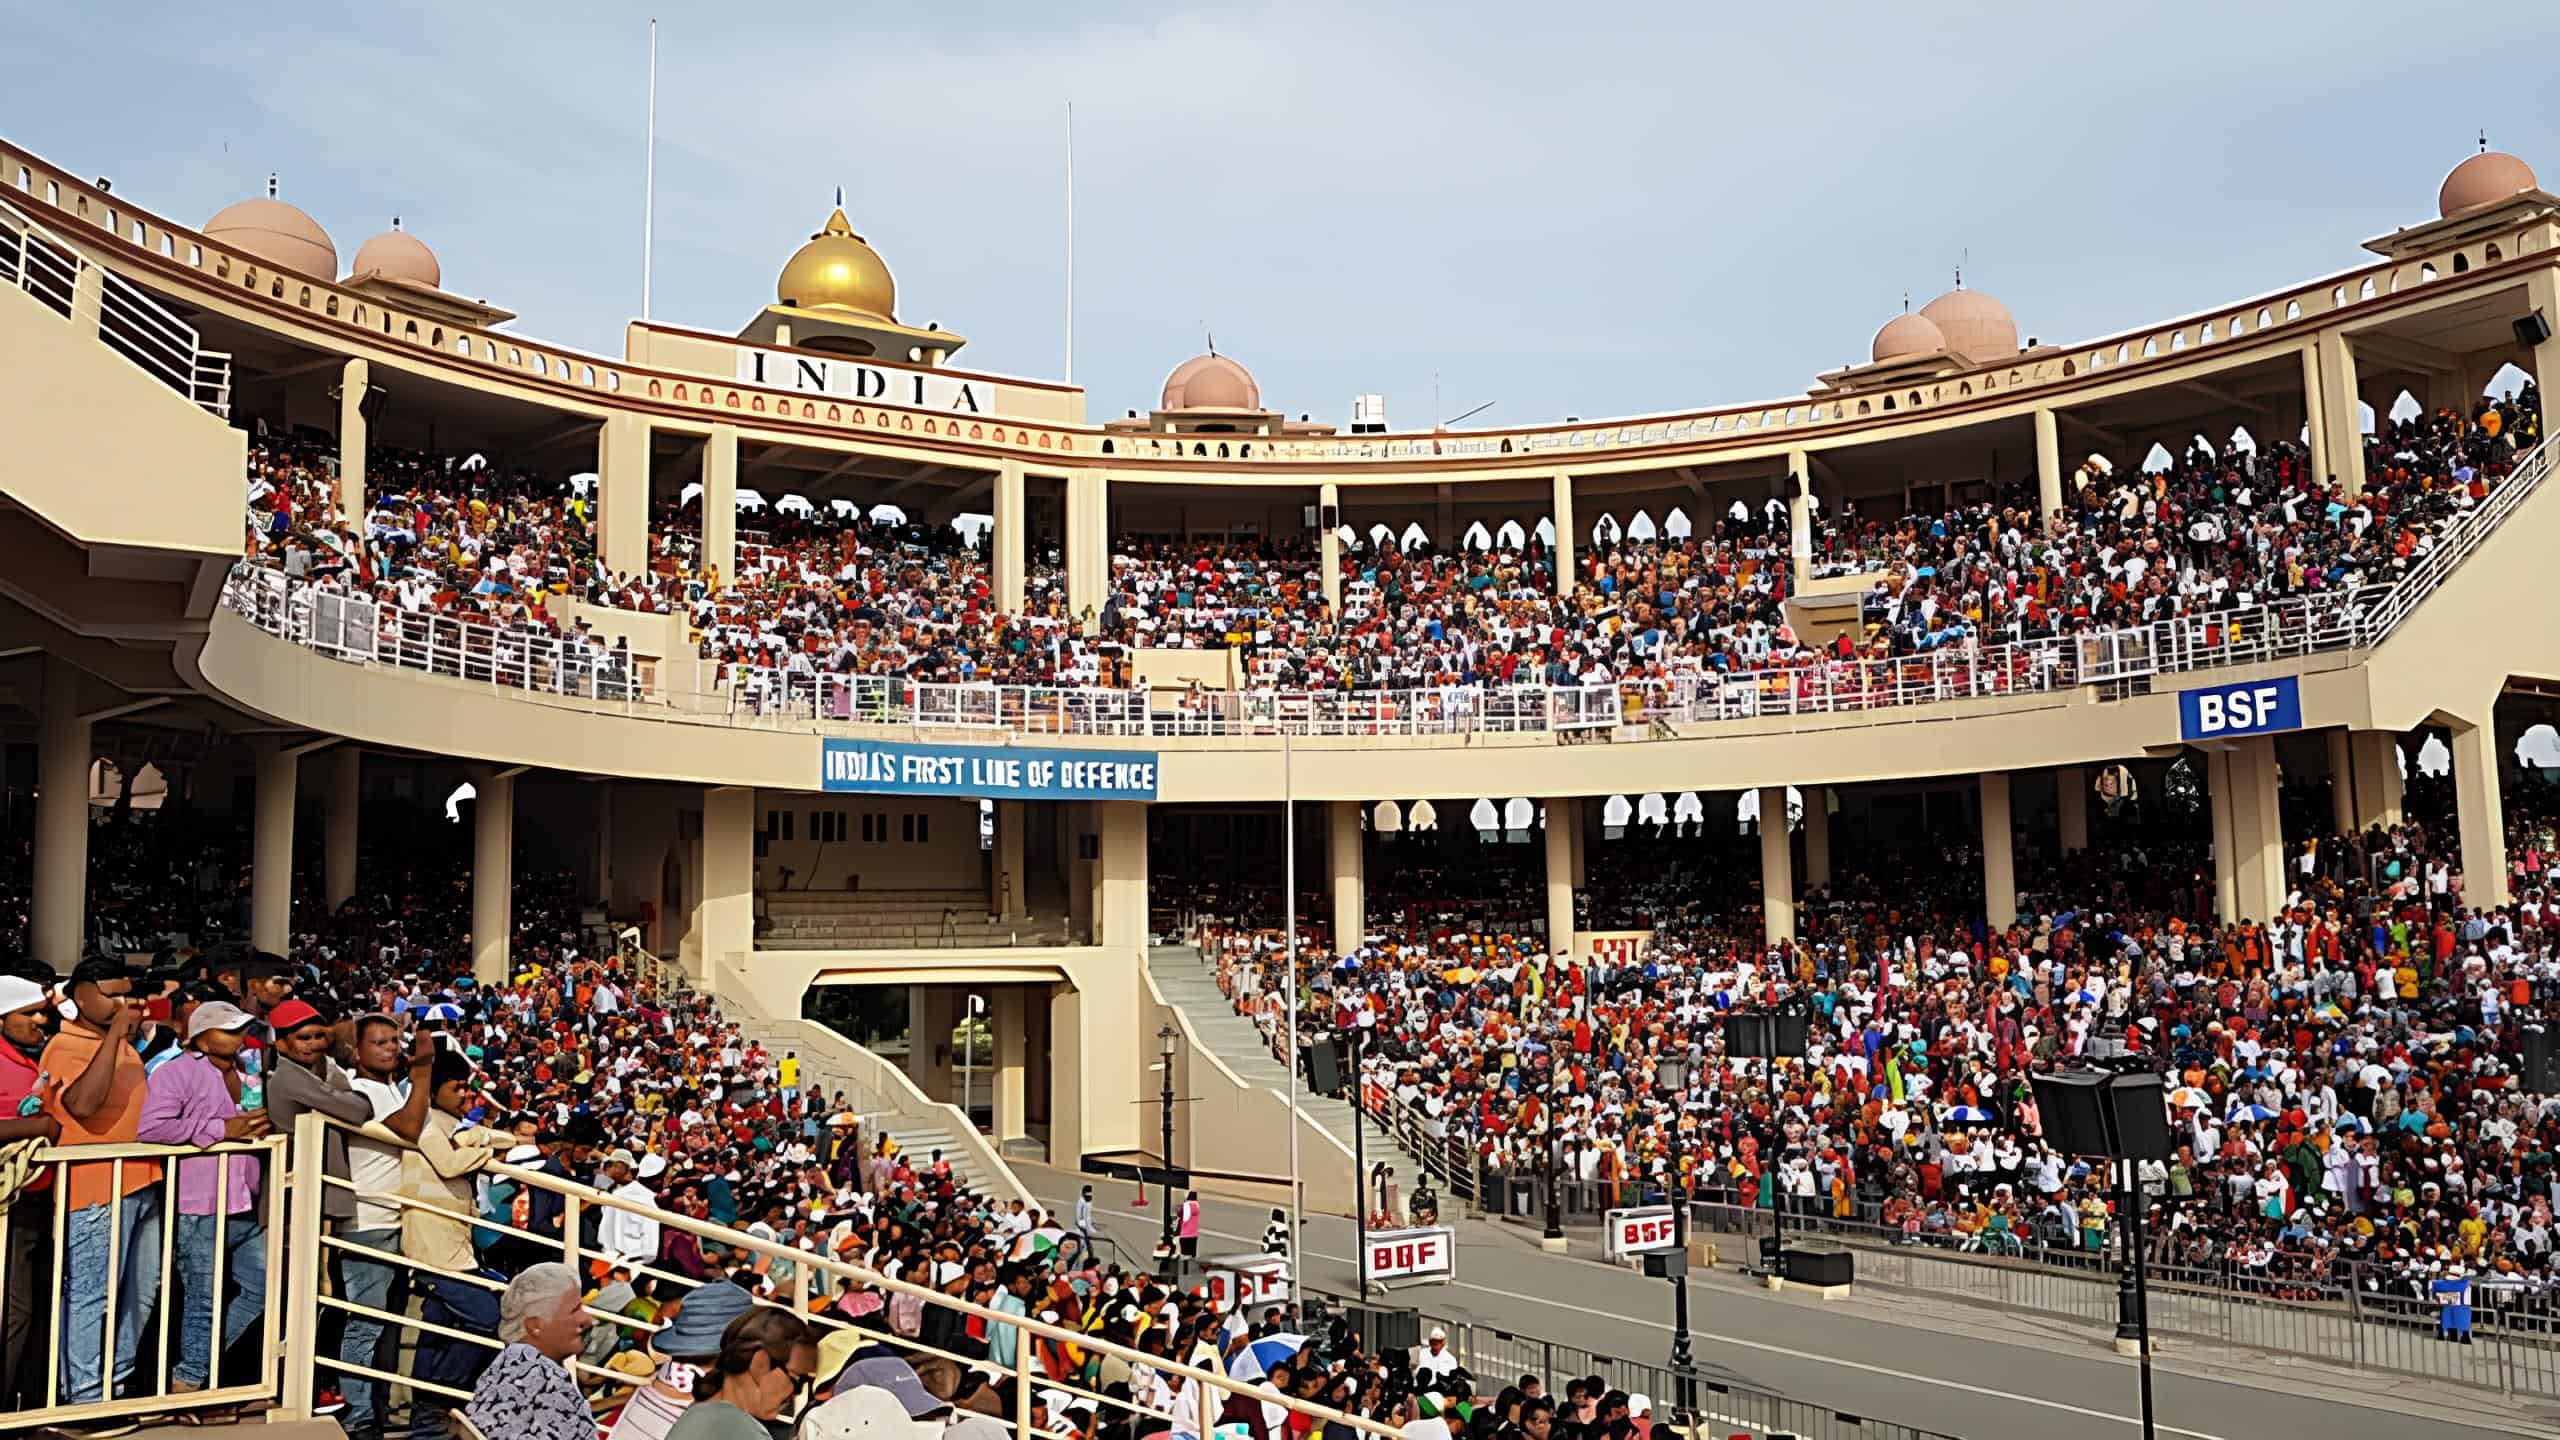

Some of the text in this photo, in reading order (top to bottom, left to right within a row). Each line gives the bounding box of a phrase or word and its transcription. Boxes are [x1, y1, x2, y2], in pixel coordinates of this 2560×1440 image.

[753, 351, 979, 413] INDIA
[2199, 686, 2278, 733] BSF
[902, 754, 965, 785] FIRST
[1027, 760, 1054, 788] OF
